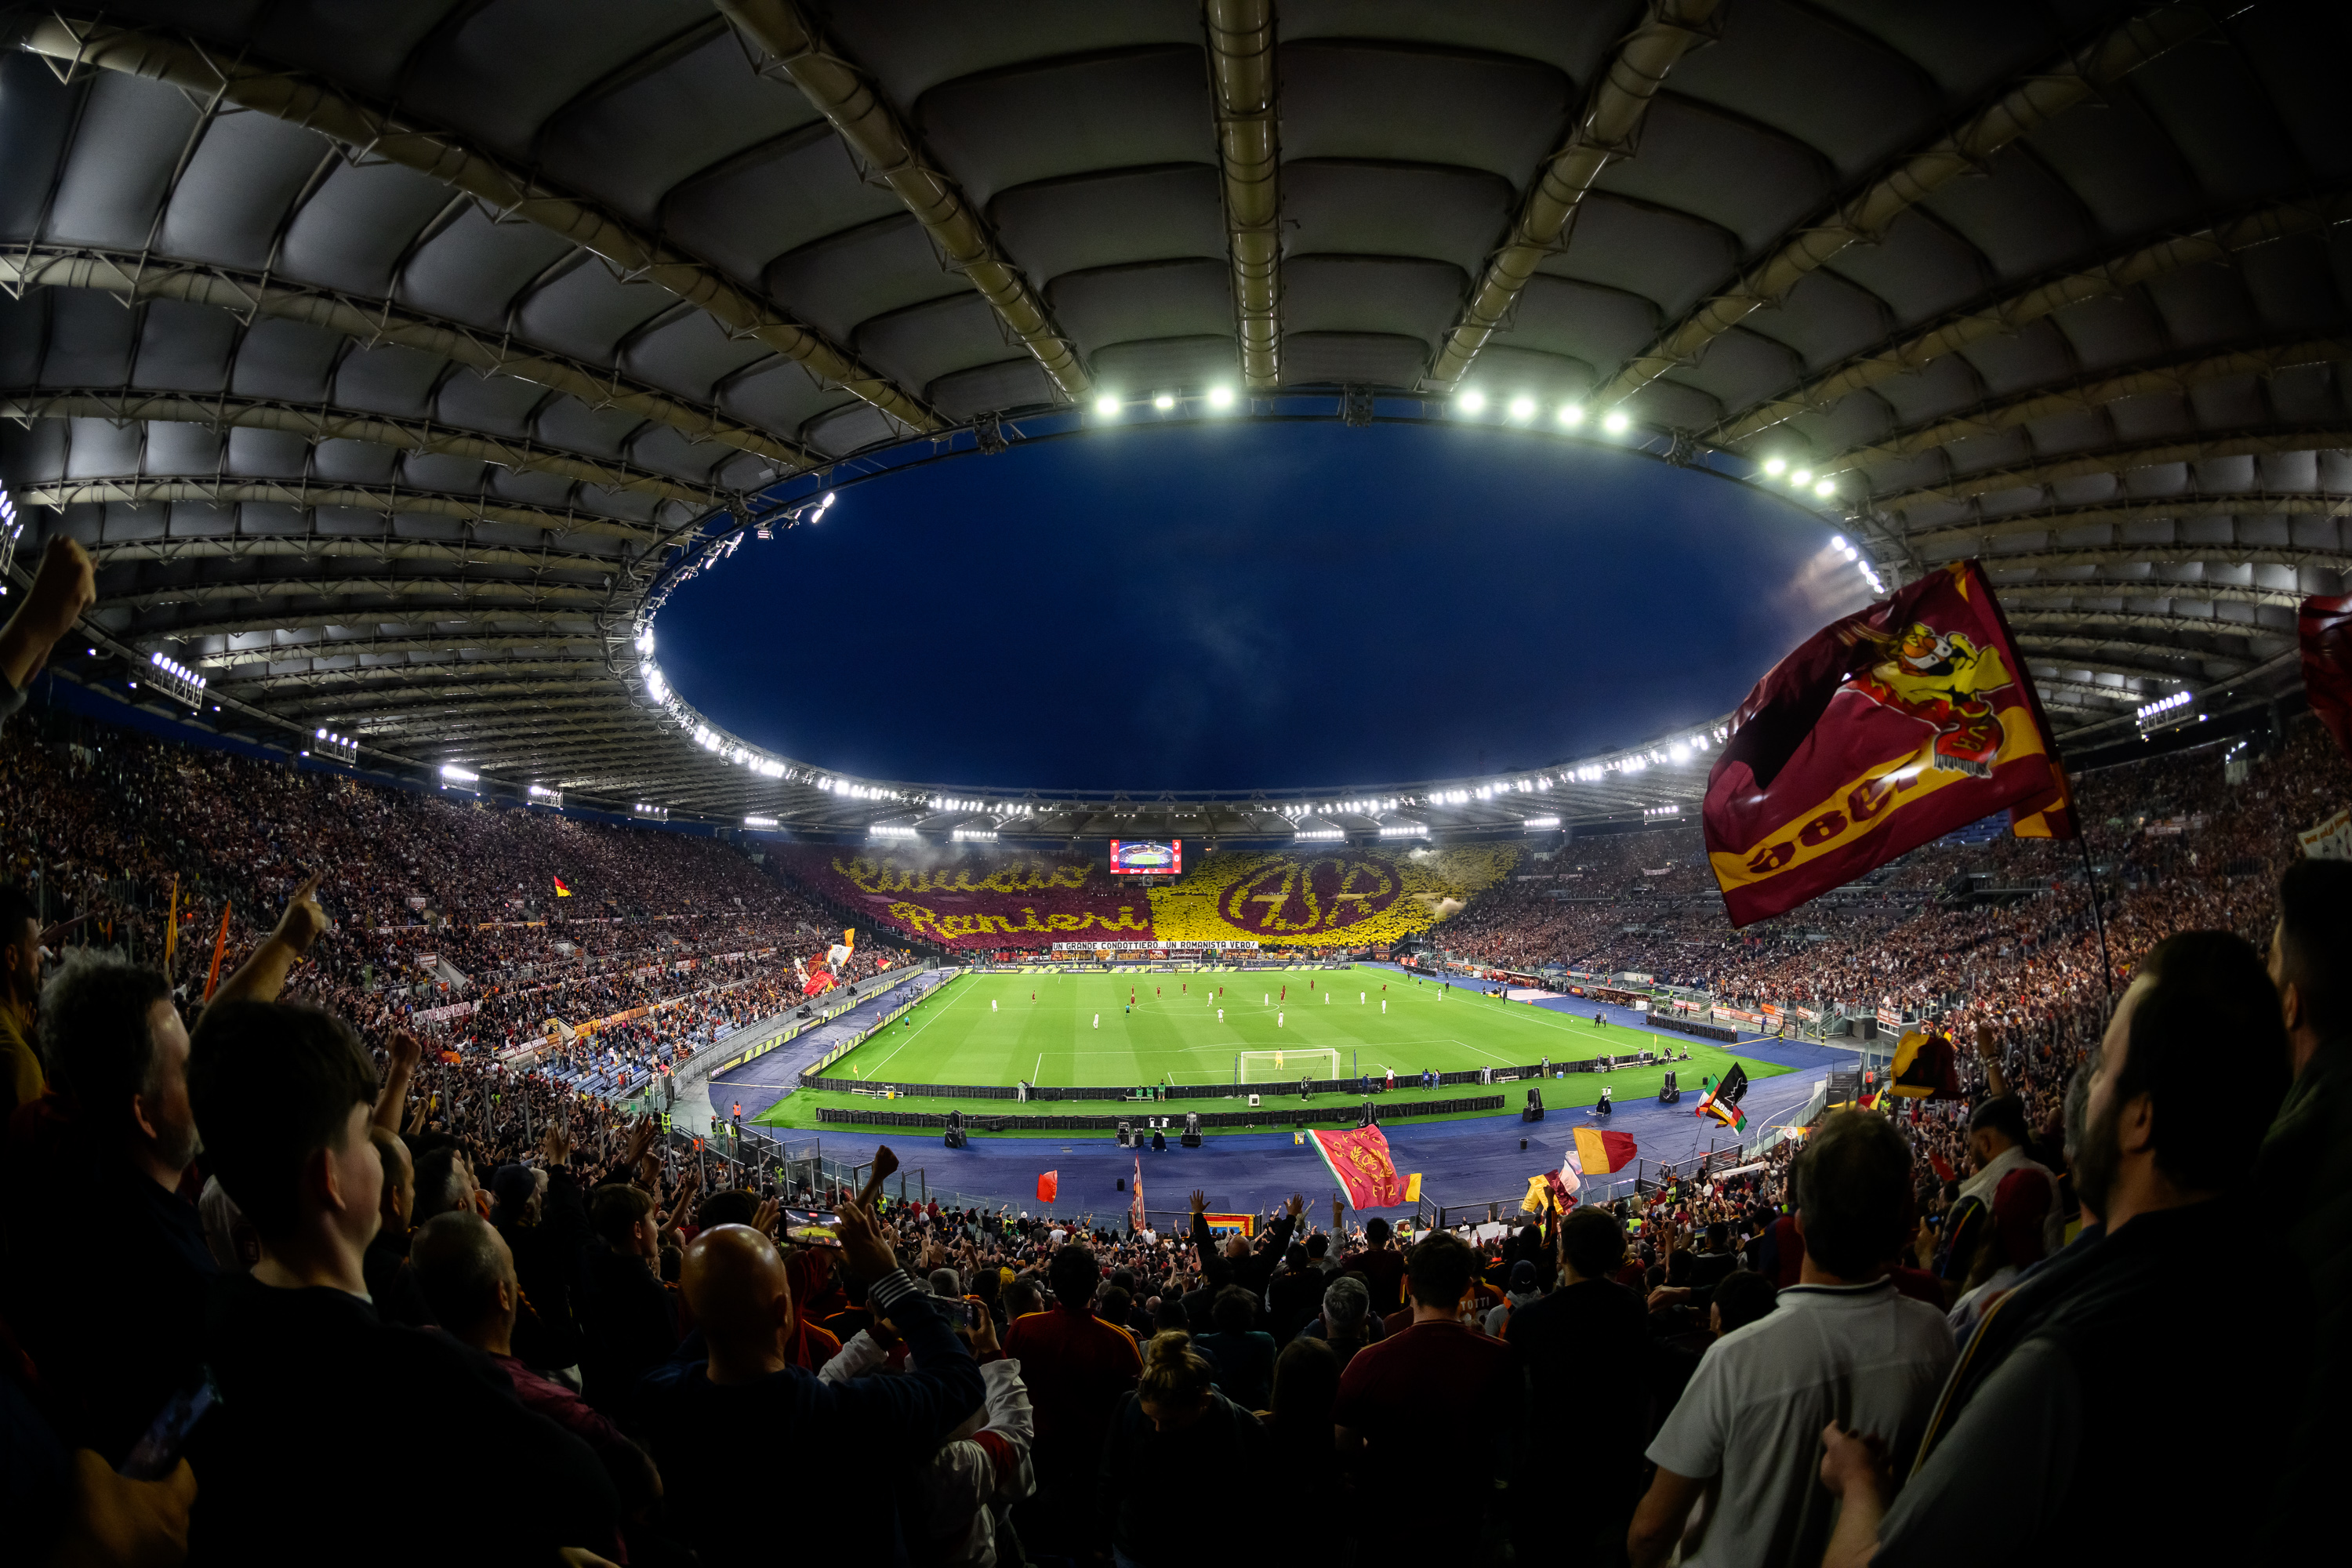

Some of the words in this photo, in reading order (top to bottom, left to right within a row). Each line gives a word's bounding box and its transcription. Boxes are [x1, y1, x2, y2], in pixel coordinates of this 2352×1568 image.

[887, 901, 1148, 939] Ranieri
[1712, 1098, 1733, 1119] ROMA
[1461, 1296, 1489, 1311] TOTTI
